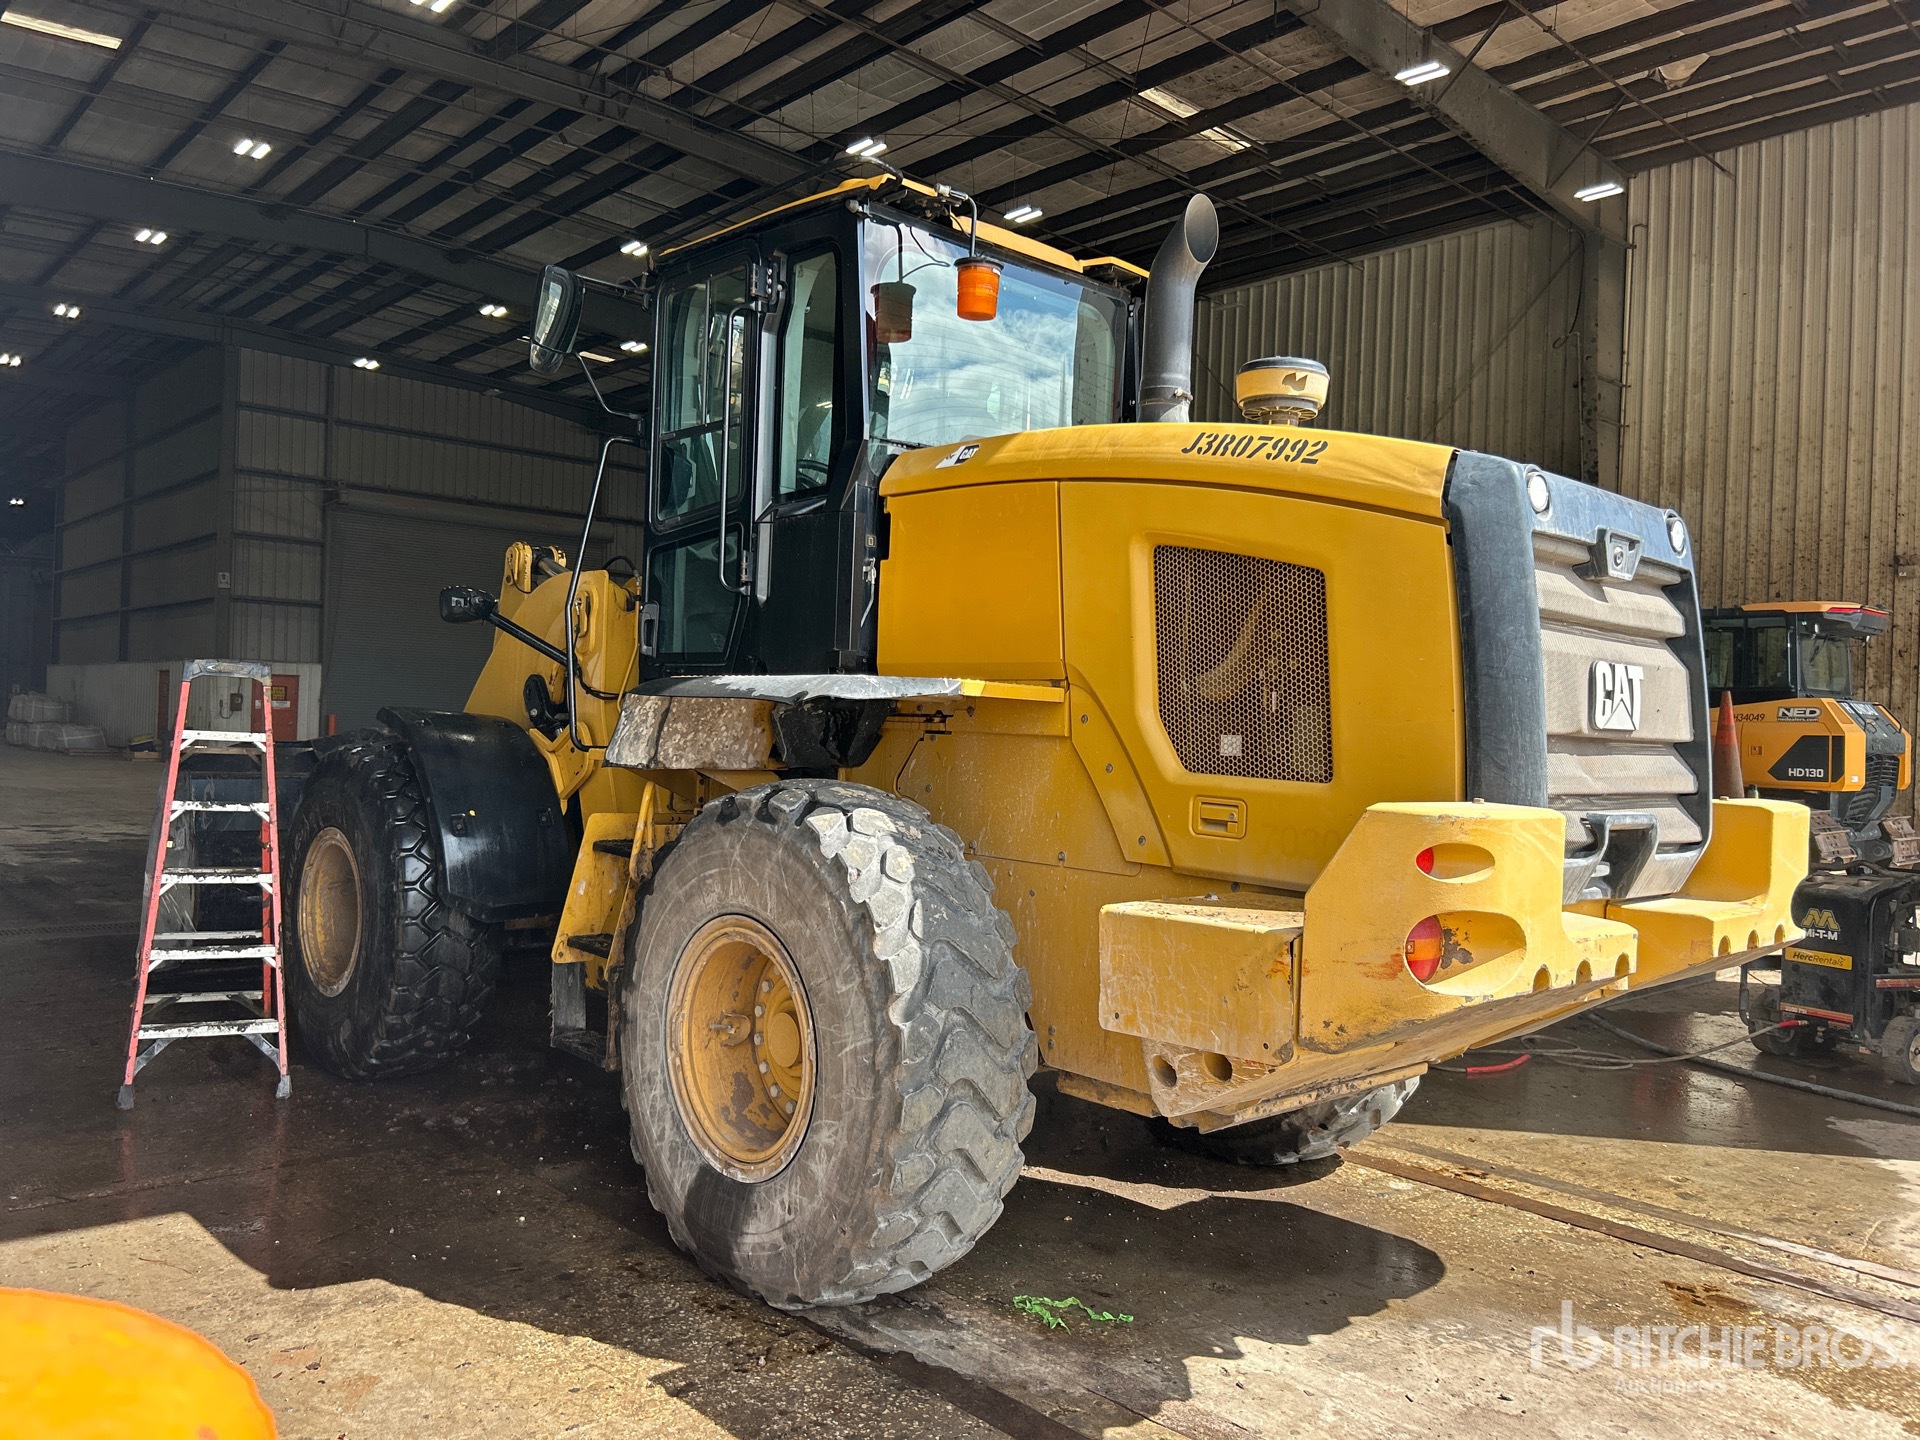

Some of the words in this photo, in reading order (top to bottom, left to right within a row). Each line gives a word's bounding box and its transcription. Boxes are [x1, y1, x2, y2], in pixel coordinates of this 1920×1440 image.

[1181, 432, 1328, 465] J3R07992
[1593, 660, 1645, 731] CAT
[1778, 707, 1822, 718] NED
[1788, 767, 1824, 778] HD130
